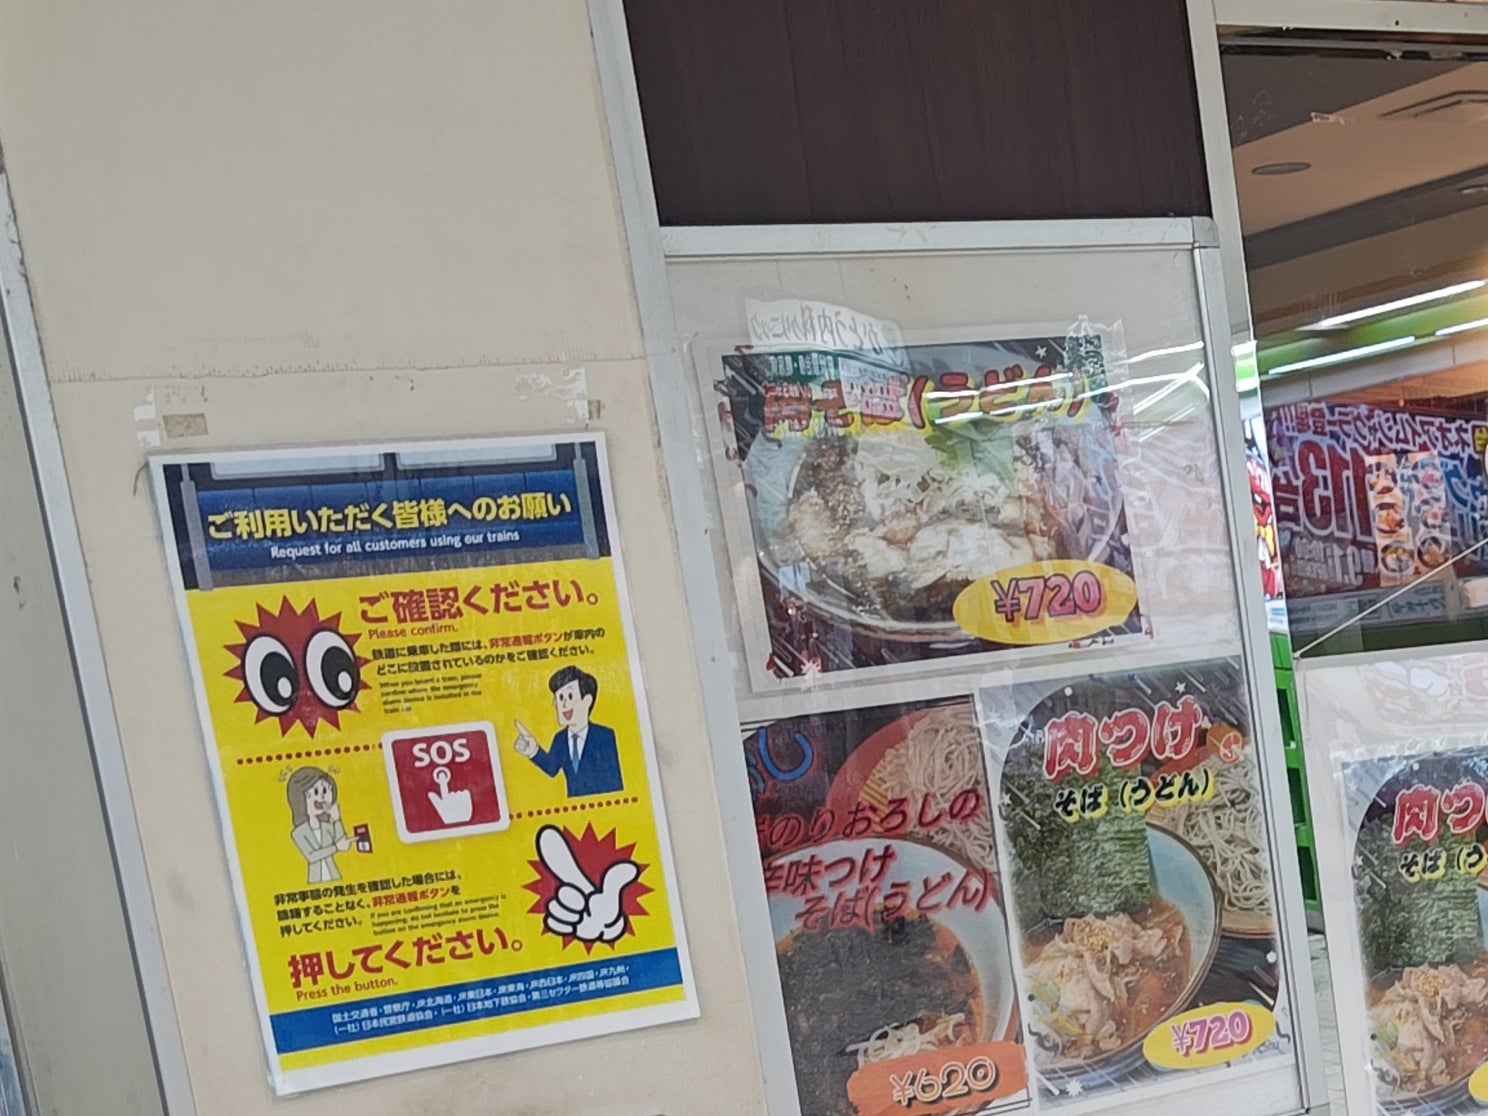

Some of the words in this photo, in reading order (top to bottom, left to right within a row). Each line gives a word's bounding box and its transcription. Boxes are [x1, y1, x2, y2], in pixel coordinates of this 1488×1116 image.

[207, 491, 572, 541] ご利用いただく皆様へのお願い
[271, 543, 321, 560] Request
[324, 541, 342, 555] for
[346, 540, 362, 553] all
[365, 537, 427, 552] customers
[430, 534, 461, 549] using
[465, 532, 484, 545] our
[487, 530, 520, 543] trains
[359, 579, 599, 624] ご確認ください。
[995, 570, 1102, 622] ¥720
[368, 625, 407, 640] Please
[411, 622, 458, 637] confirm.
[412, 738, 471, 768] SOS
[1045, 696, 1203, 778] 肉つけ
[1055, 770, 1211, 820] そば(うどん)
[280, 916, 363, 938] 押してください。
[288, 927, 523, 989] 押してください。
[296, 987, 328, 1001] Press
[331, 984, 351, 997] the
[354, 978, 399, 993] button.
[1172, 1012, 1250, 1057] ¥720
[891, 1057, 997, 1108] ¥620
